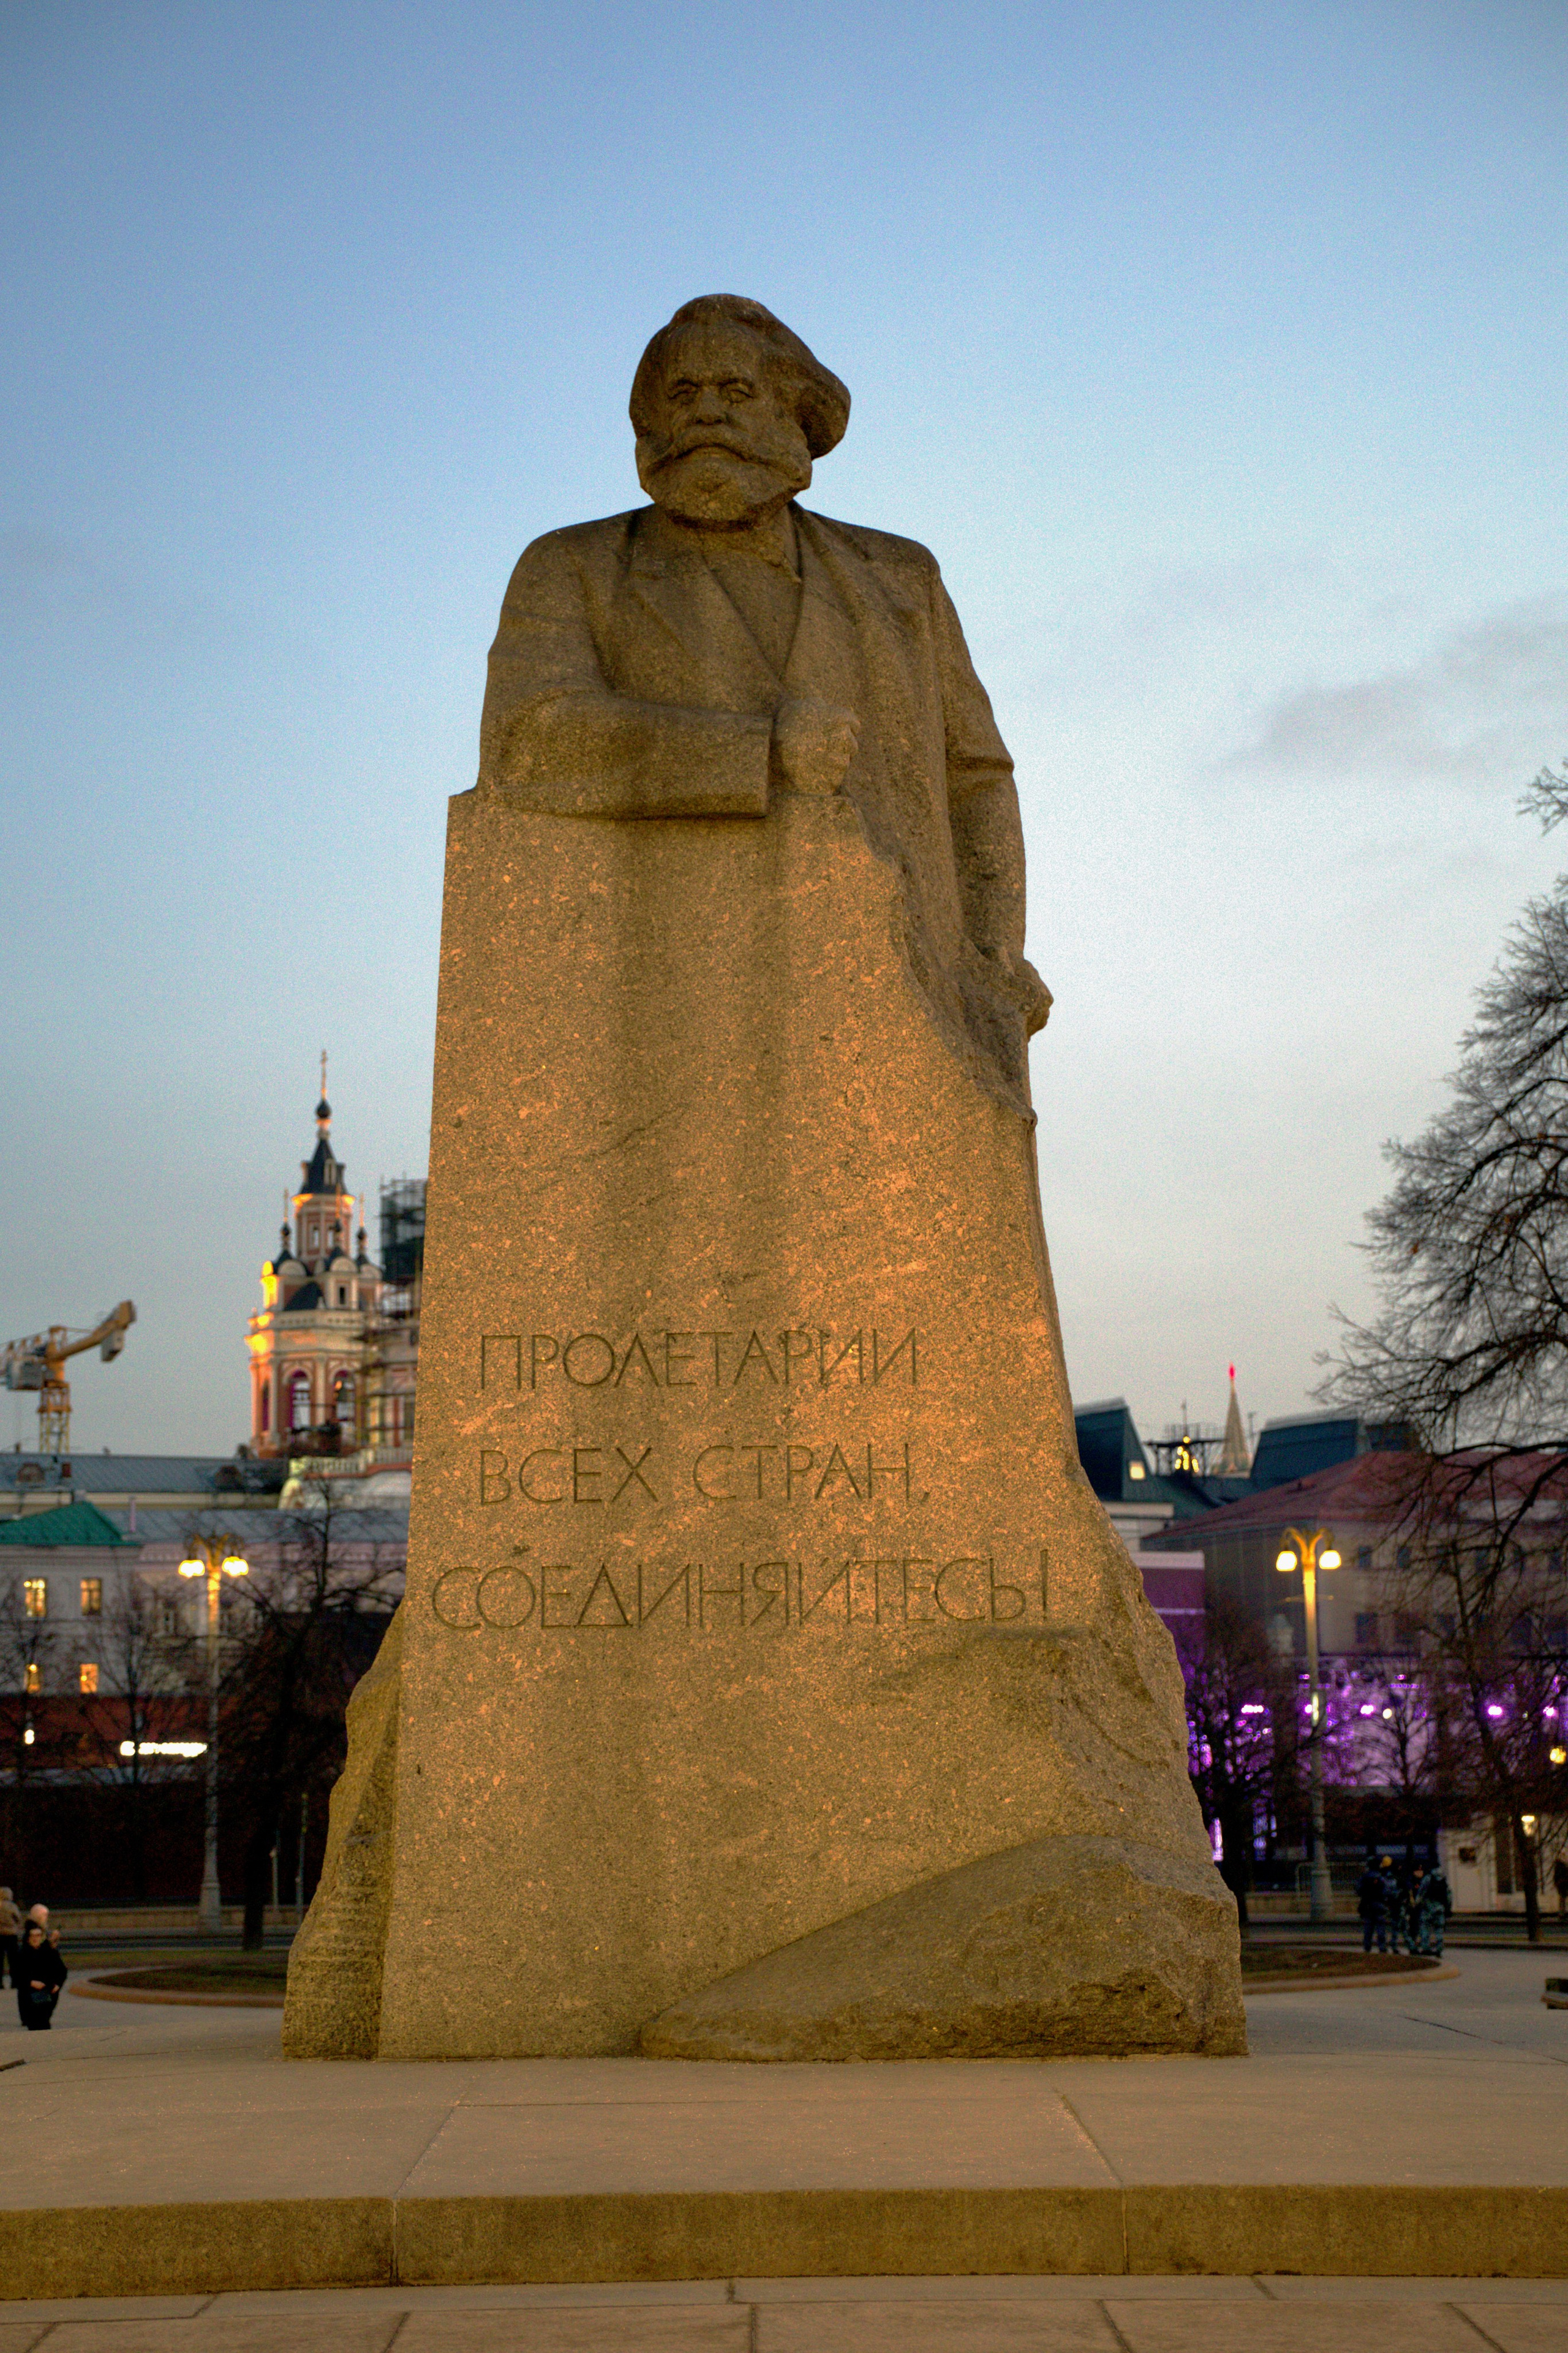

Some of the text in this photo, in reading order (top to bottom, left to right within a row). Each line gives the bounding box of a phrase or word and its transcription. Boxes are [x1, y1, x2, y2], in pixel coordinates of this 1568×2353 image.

[480, 1326, 918, 1390] ПРОЛЕТАРИИ
[480, 1443, 930, 1506] ВСЕХ СТРАН,
[432, 1549, 1048, 1630] СОЕДИНЯЙТЕСЬ!
